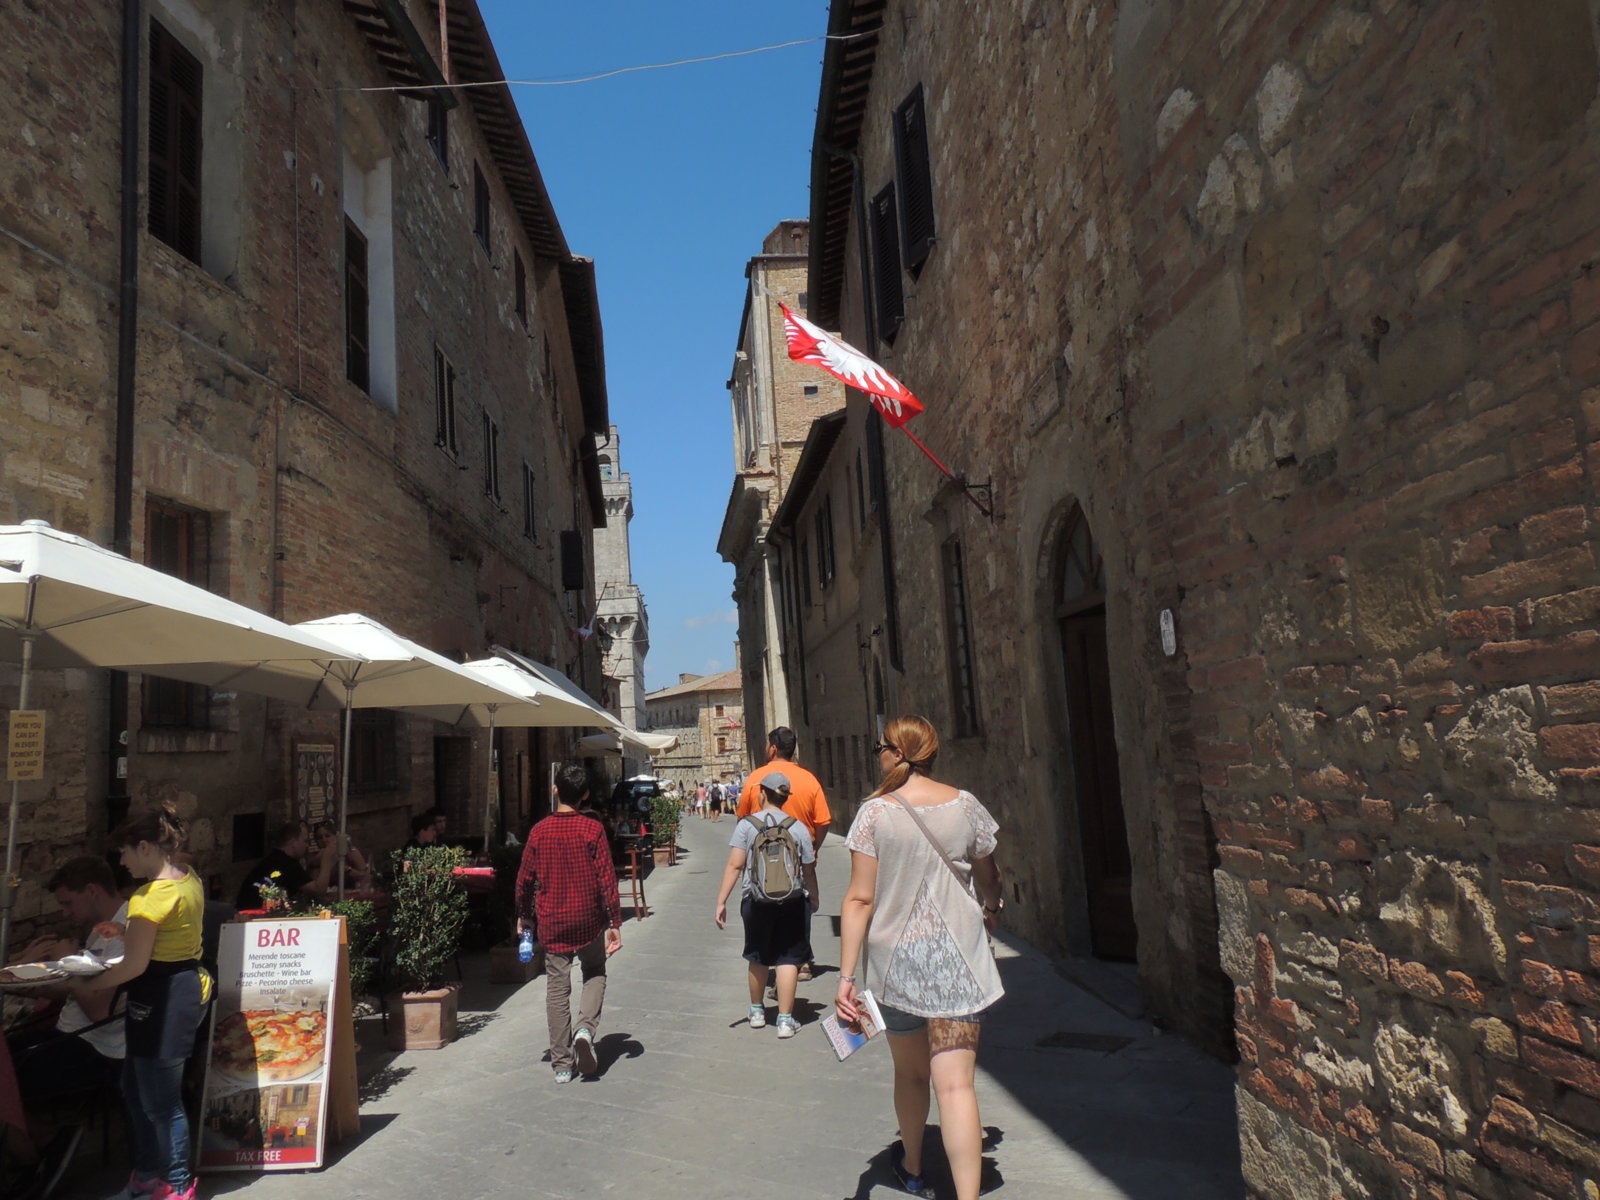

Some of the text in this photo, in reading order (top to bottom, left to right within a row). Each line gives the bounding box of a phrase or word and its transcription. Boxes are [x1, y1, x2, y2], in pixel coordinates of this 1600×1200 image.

[257, 928, 300, 947] BAR
[248, 952, 278, 960] Merende
[235, 1151, 281, 1162] TAX FREE
